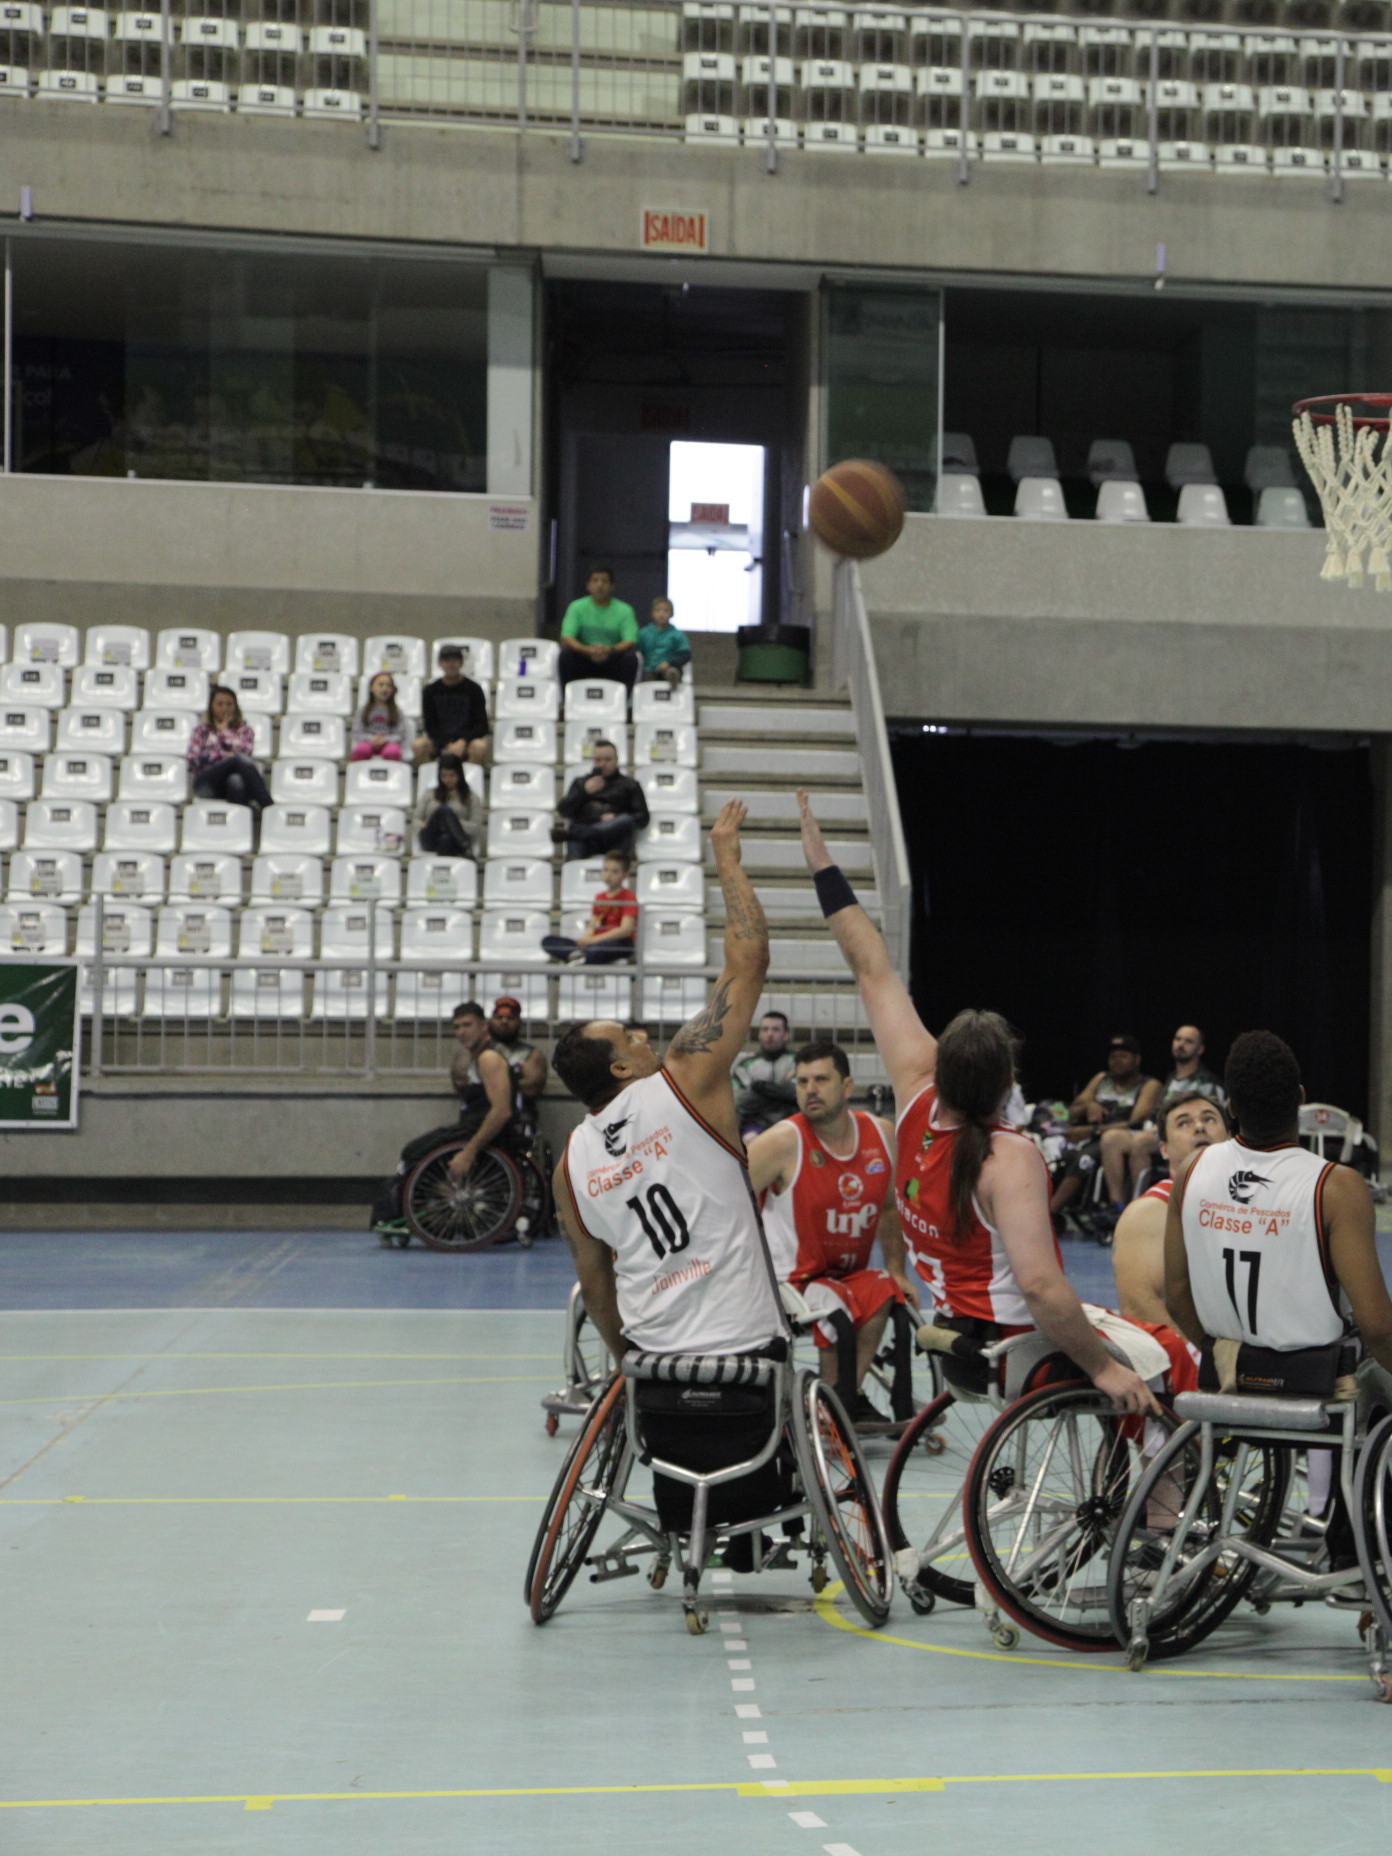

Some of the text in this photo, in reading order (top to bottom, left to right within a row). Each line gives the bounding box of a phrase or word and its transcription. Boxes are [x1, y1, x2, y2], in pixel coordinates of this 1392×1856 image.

[650, 212, 697, 245] SAÍDA
[630, 1125, 671, 1155] Pescados
[587, 1160, 644, 1198] Classe
[625, 1183, 690, 1260] 10
[1199, 1209, 1252, 1234] Classe
[1237, 1206, 1249, 1215] de
[1251, 1206, 1291, 1218] Pescados
[651, 1257, 712, 1295] Joinville
[1222, 1247, 1261, 1336] 17
